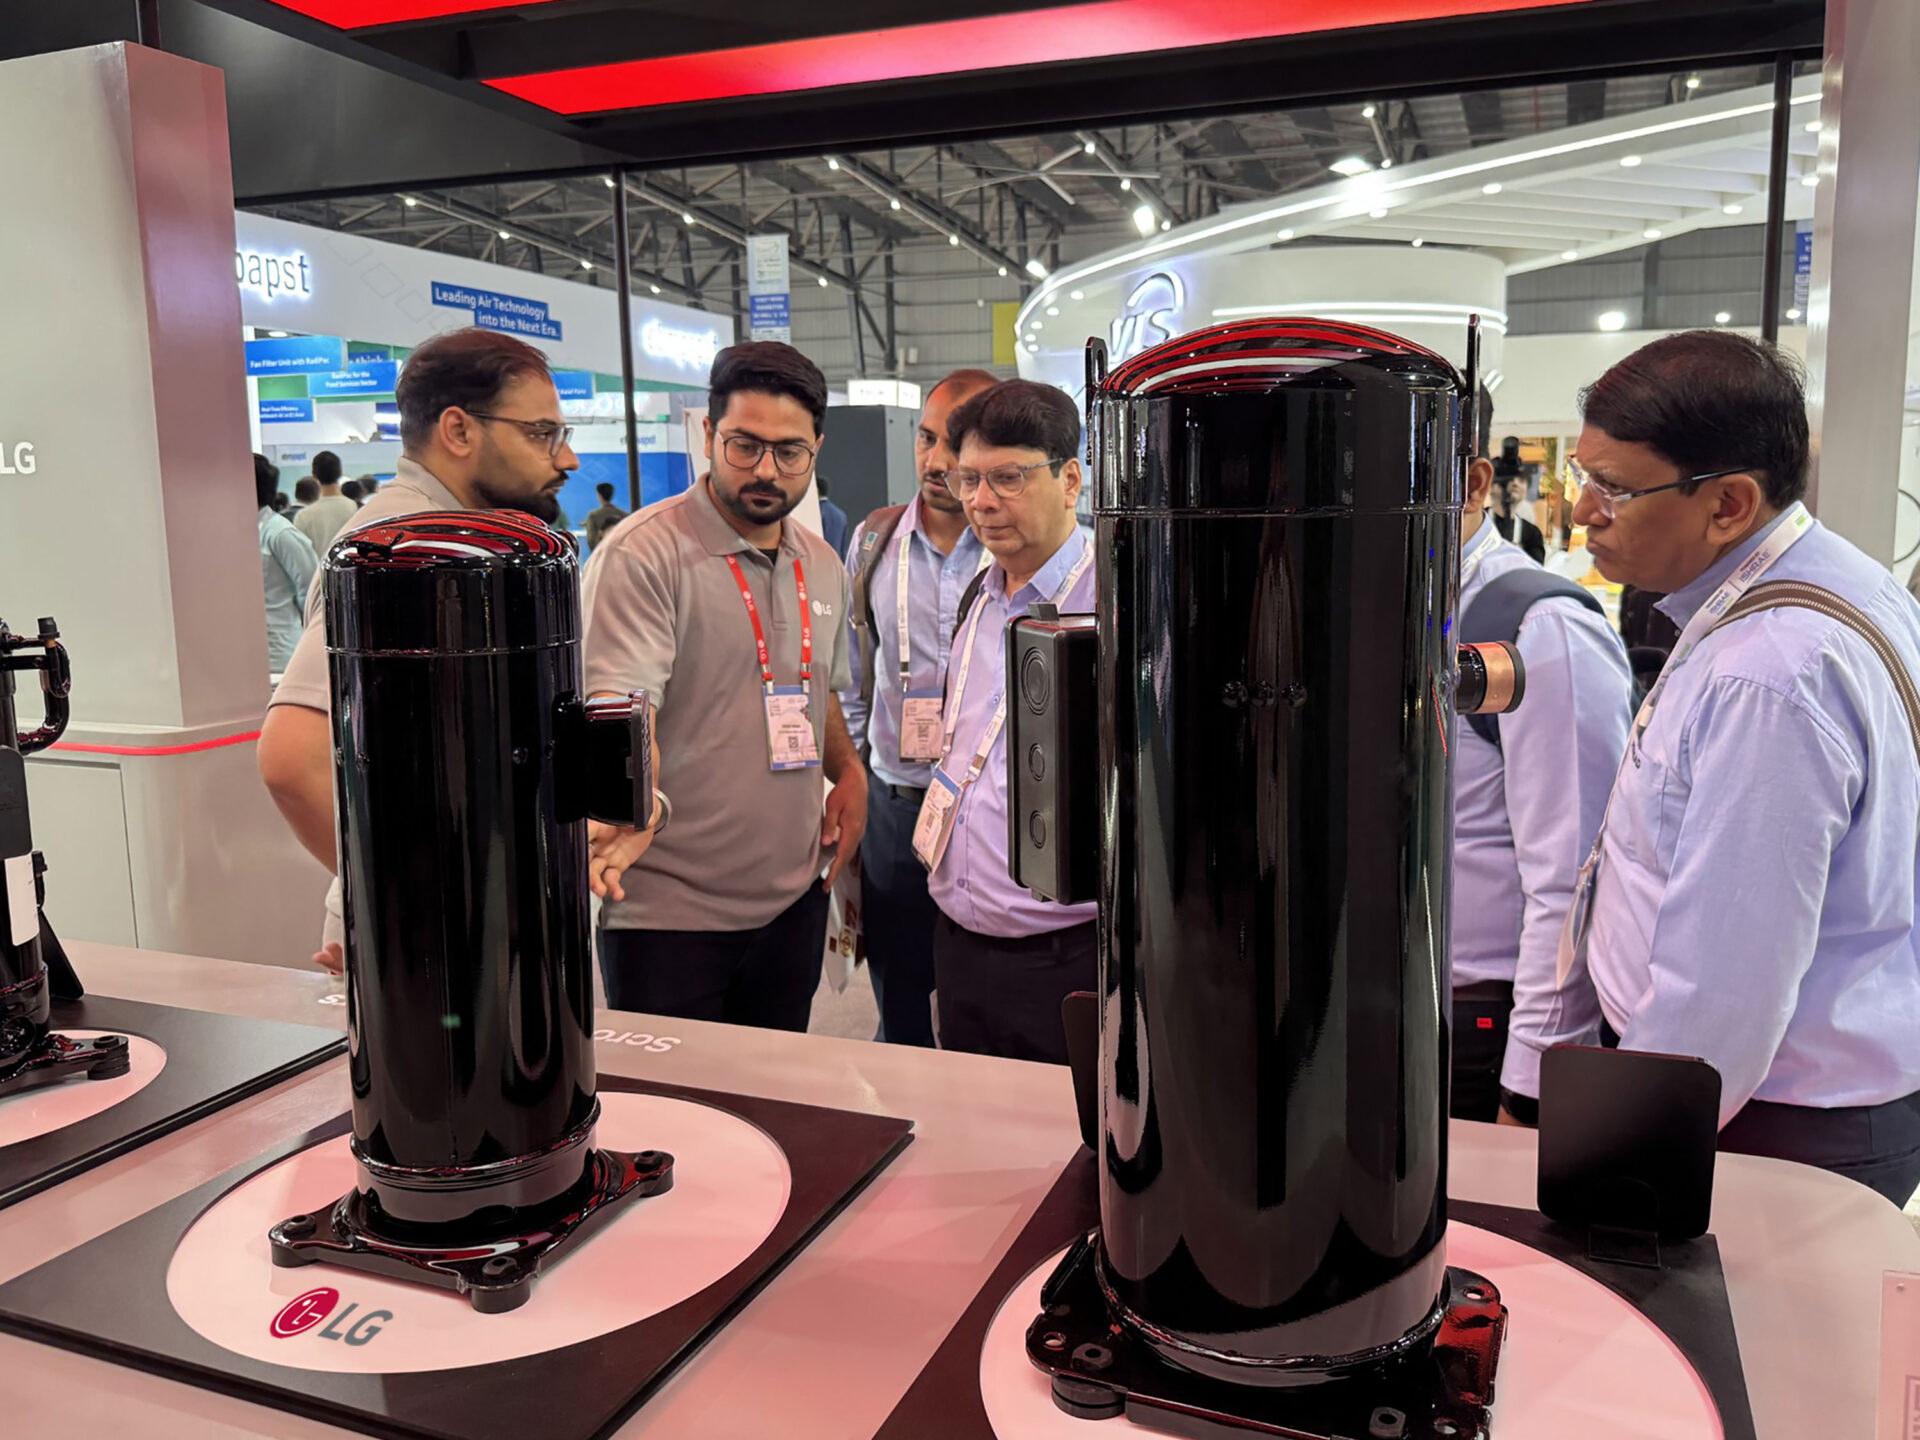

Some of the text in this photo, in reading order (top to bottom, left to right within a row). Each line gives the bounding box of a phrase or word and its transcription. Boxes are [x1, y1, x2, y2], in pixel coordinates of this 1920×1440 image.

[435, 287, 545, 320] Leading Air Technology
[478, 311, 560, 337] into the Next Era.
[0, 442, 36, 474] LG
[1740, 549, 1771, 582] ISHRAE
[822, 604, 832, 616] LG
[317, 1303, 393, 1346] LG
